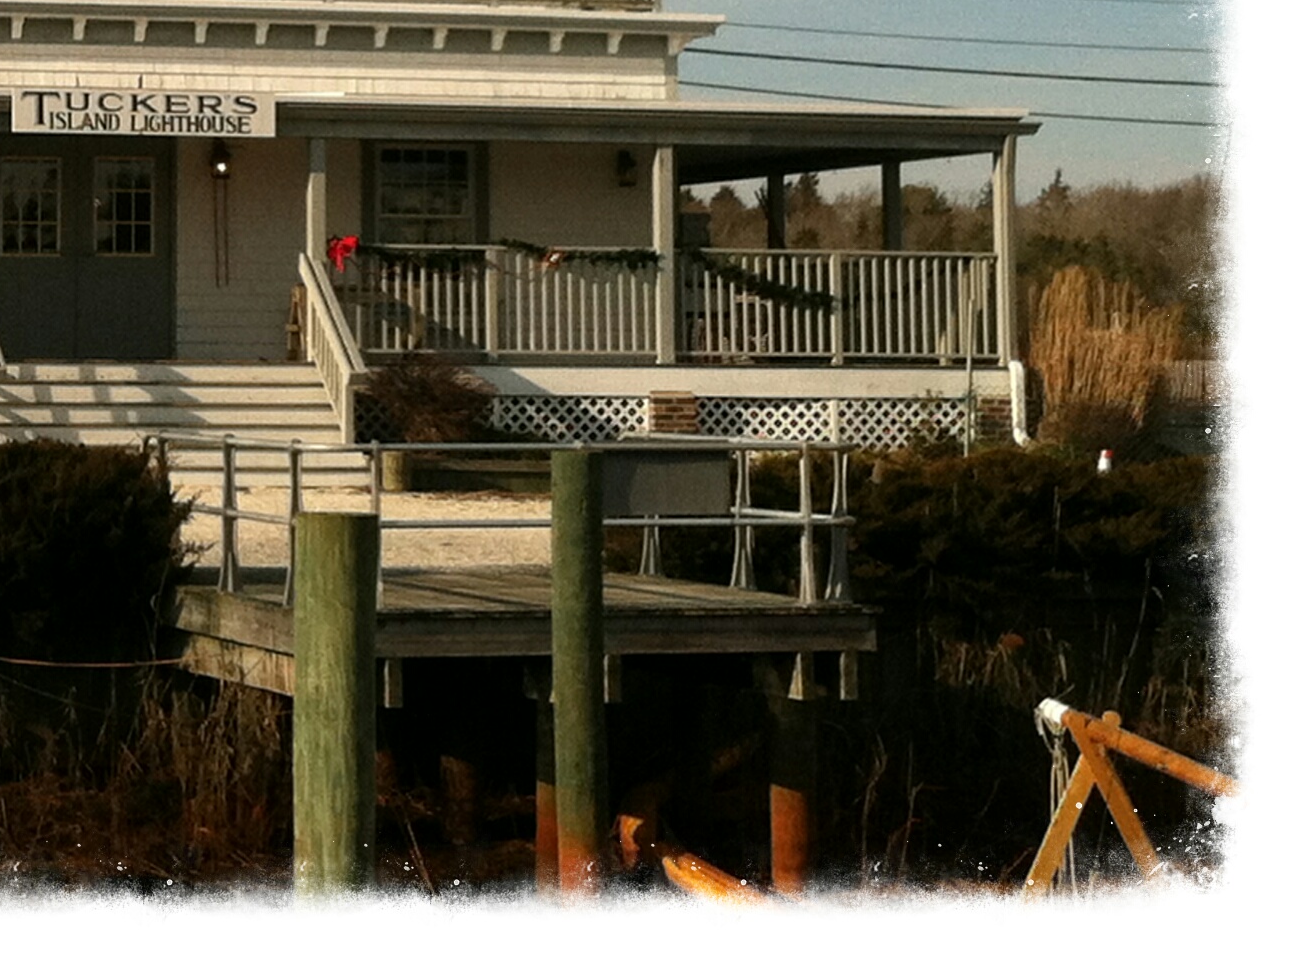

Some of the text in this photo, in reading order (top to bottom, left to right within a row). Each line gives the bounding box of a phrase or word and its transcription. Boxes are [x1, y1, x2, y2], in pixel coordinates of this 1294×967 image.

[21, 91, 258, 125] TUCKER'S
[49, 112, 252, 133] ISLAND LIGHTHOUSE
